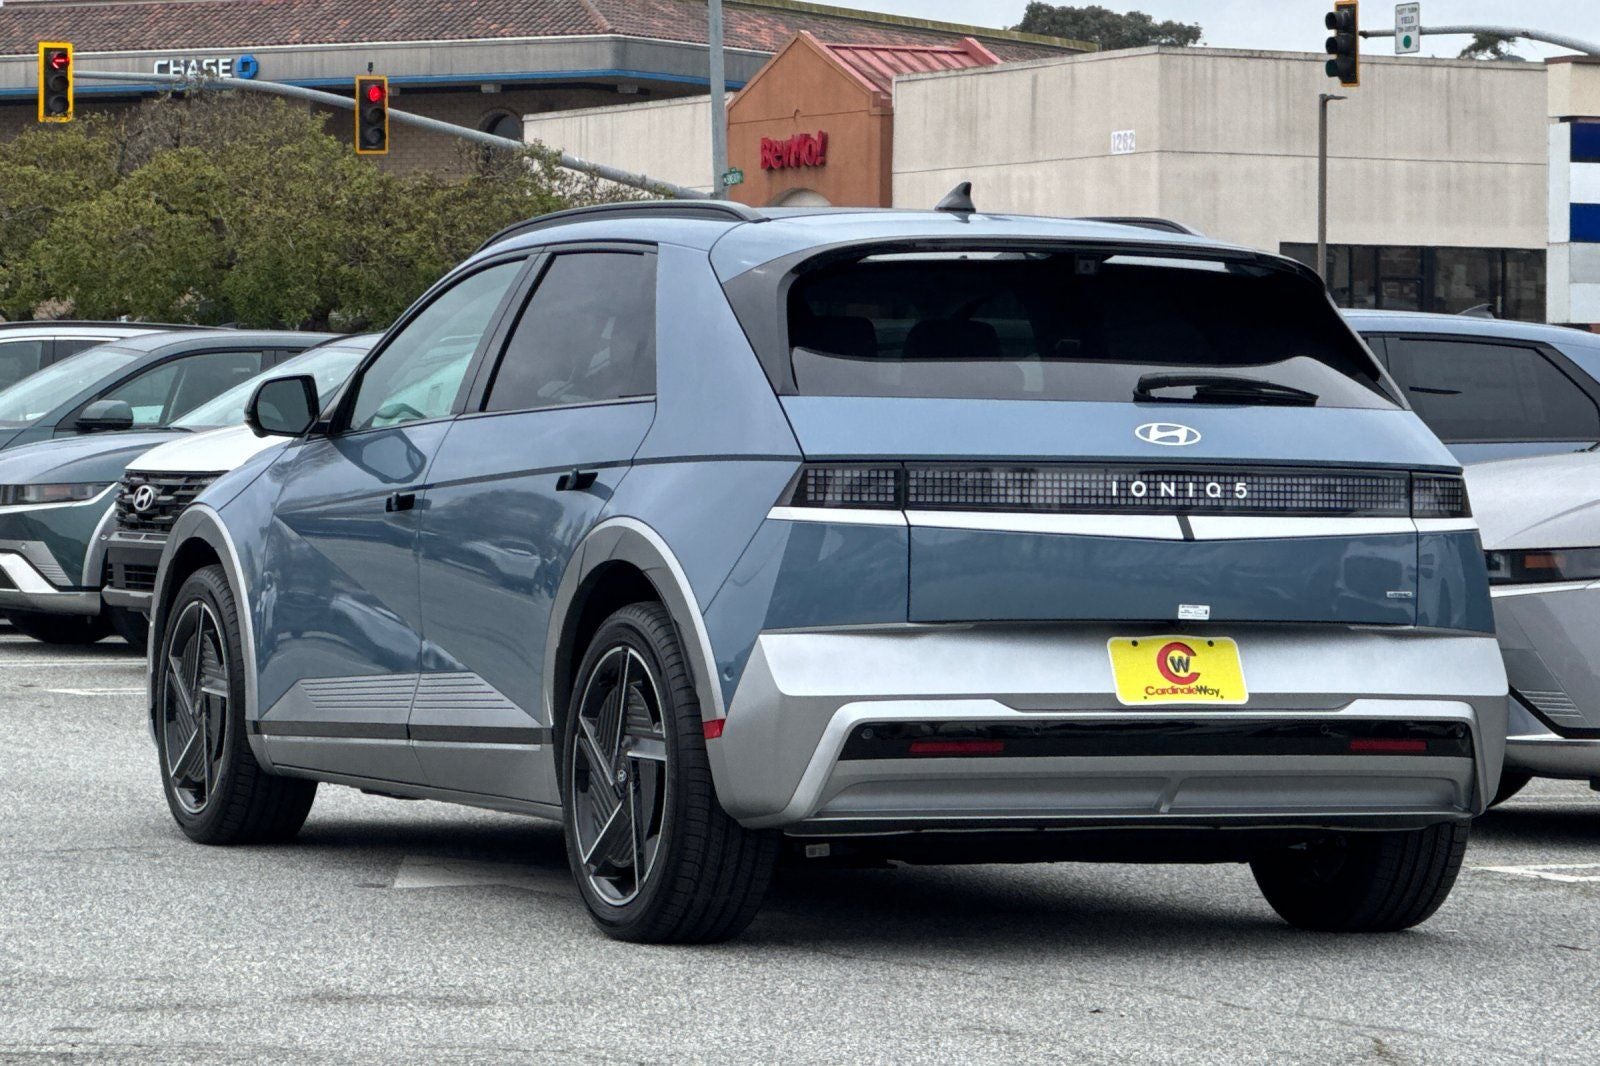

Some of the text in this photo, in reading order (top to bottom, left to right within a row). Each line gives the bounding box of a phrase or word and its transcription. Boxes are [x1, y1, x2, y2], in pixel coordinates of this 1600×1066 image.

[153, 58, 232, 78] CHASE
[1112, 480, 1248, 499] IONIQ 5
